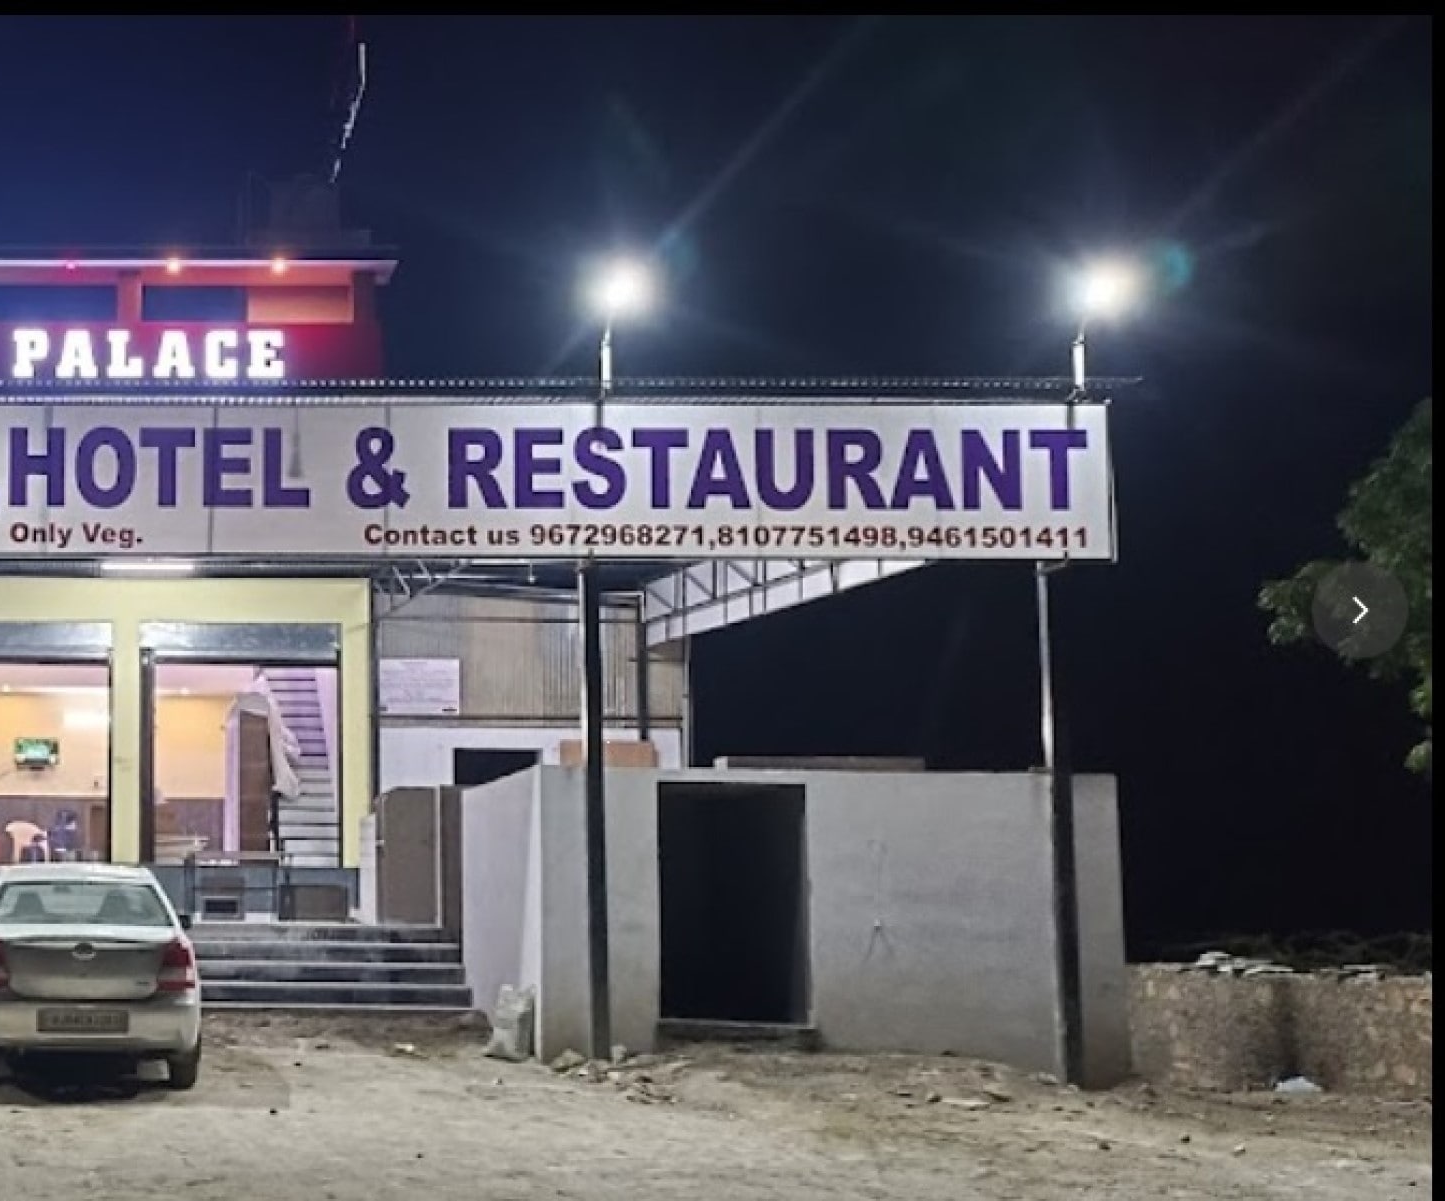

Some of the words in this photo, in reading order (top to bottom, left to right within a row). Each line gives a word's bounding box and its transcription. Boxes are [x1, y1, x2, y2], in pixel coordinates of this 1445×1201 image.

[11, 326, 287, 379] PALACE
[347, 427, 410, 510] &
[448, 428, 1087, 511] RESTAURANT
[10, 522, 73, 548] Only
[82, 523, 143, 549] Veg.
[364, 523, 477, 546] Contact
[487, 528, 520, 546] us
